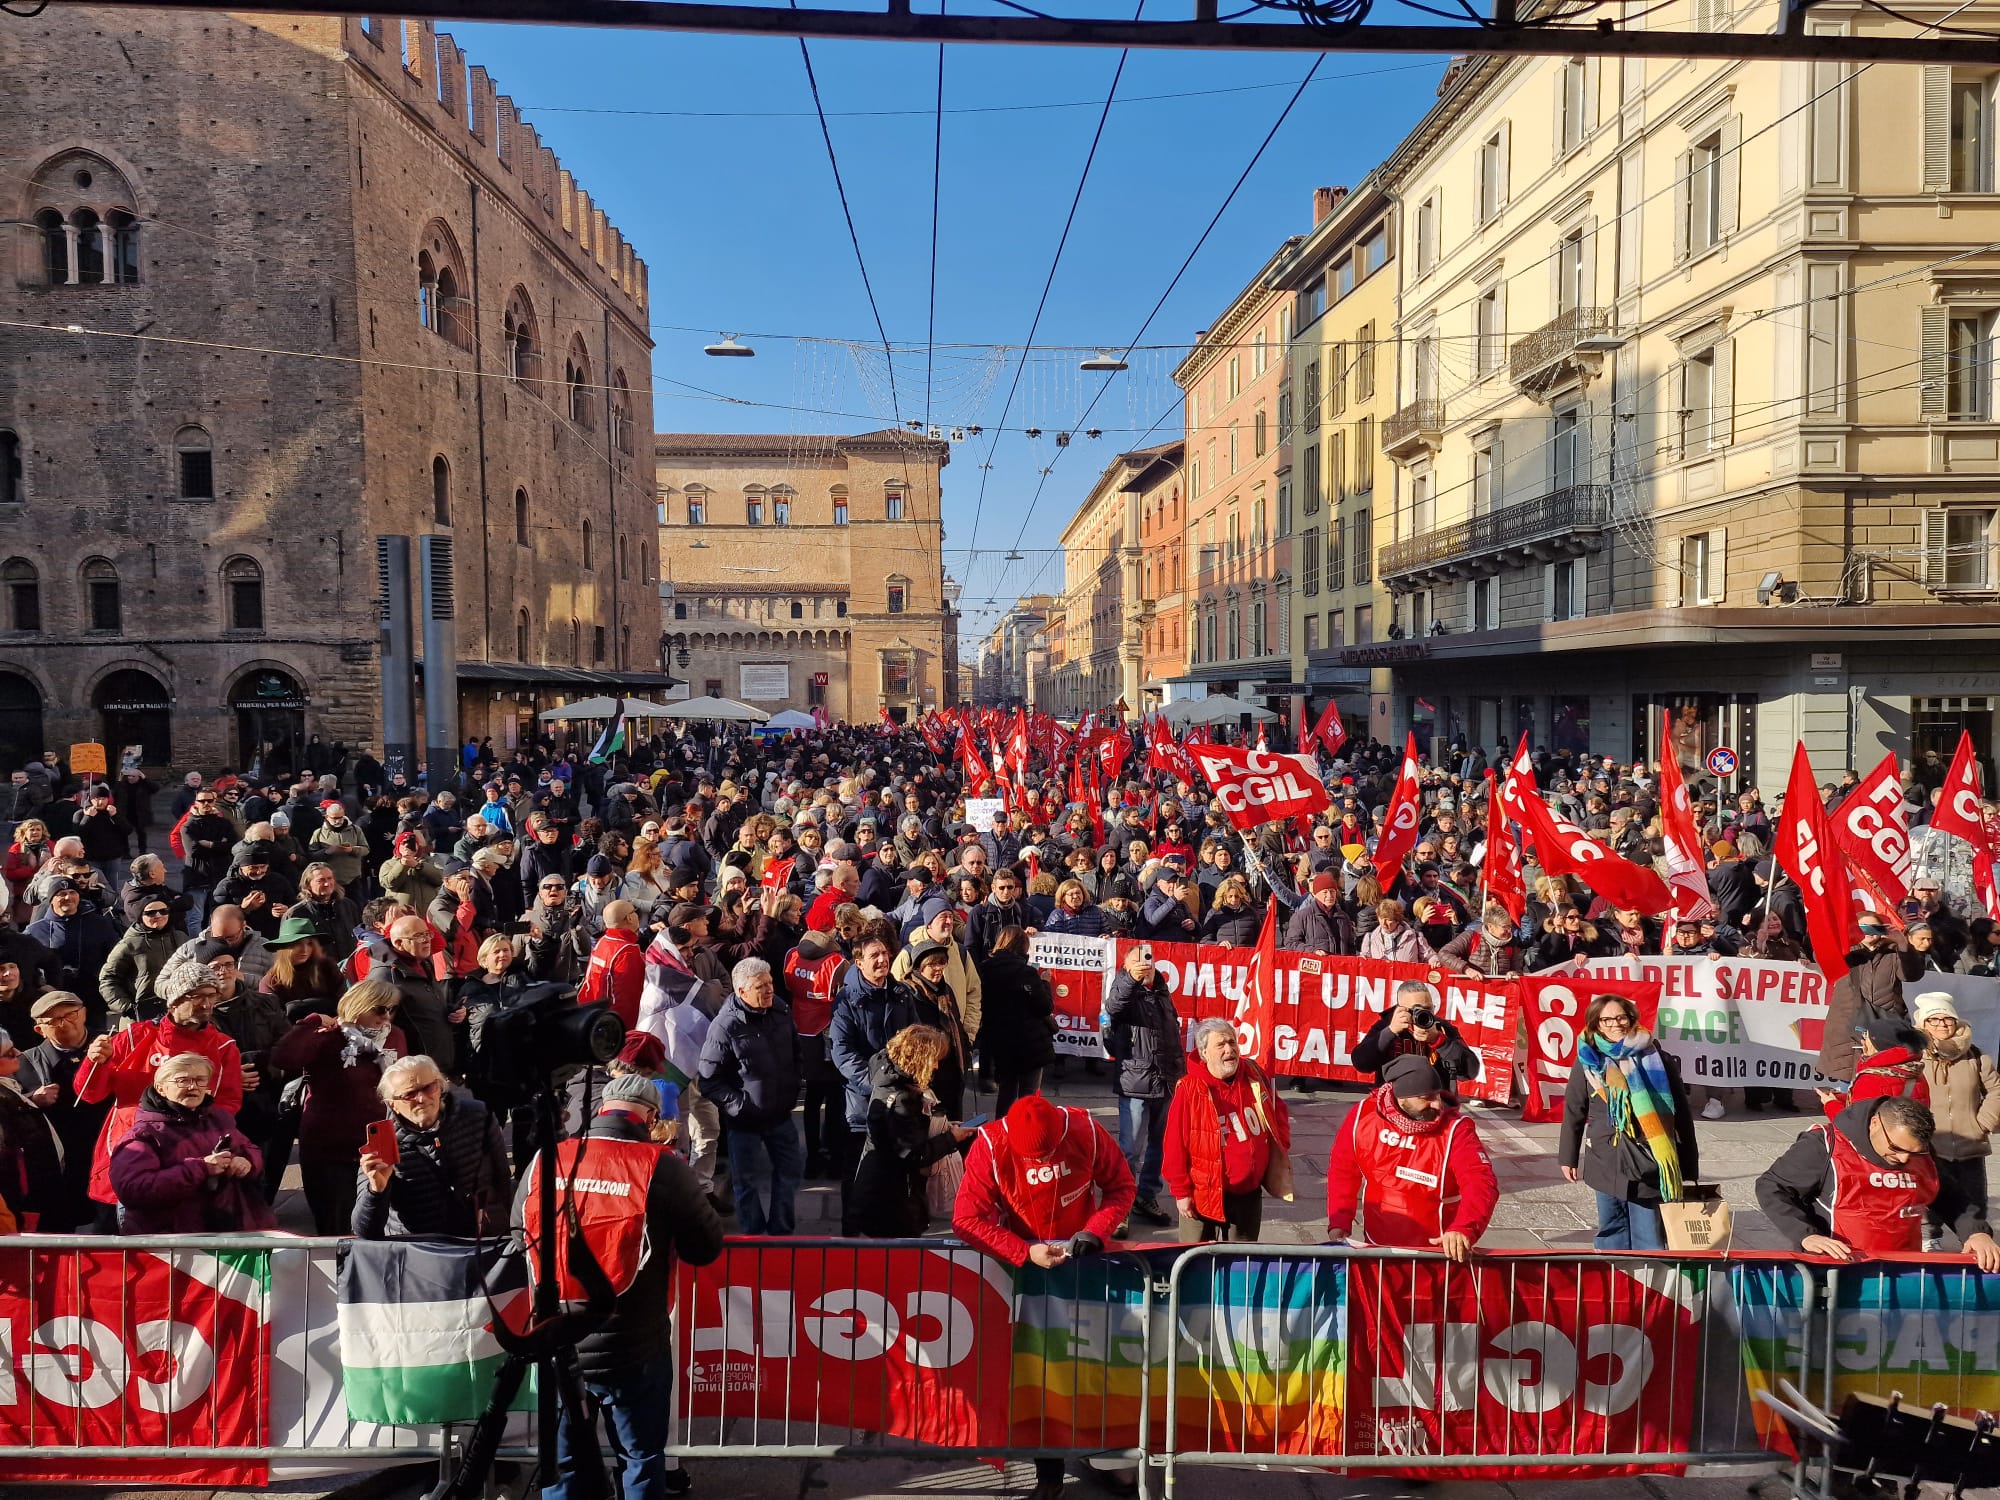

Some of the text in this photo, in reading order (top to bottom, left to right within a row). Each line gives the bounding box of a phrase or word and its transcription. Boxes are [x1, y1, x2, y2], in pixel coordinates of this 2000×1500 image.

[816, 675, 827, 683] W
[1217, 772, 1312, 812] CGIL
[1035, 944, 1104, 957] FUNZIONE
[1035, 955, 1103, 968] PUBBLICA
[1054, 1014, 1091, 1030] GIL
[1657, 1007, 1741, 1045] PACE
[1695, 1055, 1747, 1078] dalla
[1756, 1058, 1838, 1083] conos
[1378, 1128, 1416, 1151] CGIL
[1026, 1161, 1072, 1186] CGIL
[1869, 1171, 1917, 1189] CGIL
[1684, 1220, 1712, 1232] THIS IS
[1690, 1231, 1711, 1245] MINE
